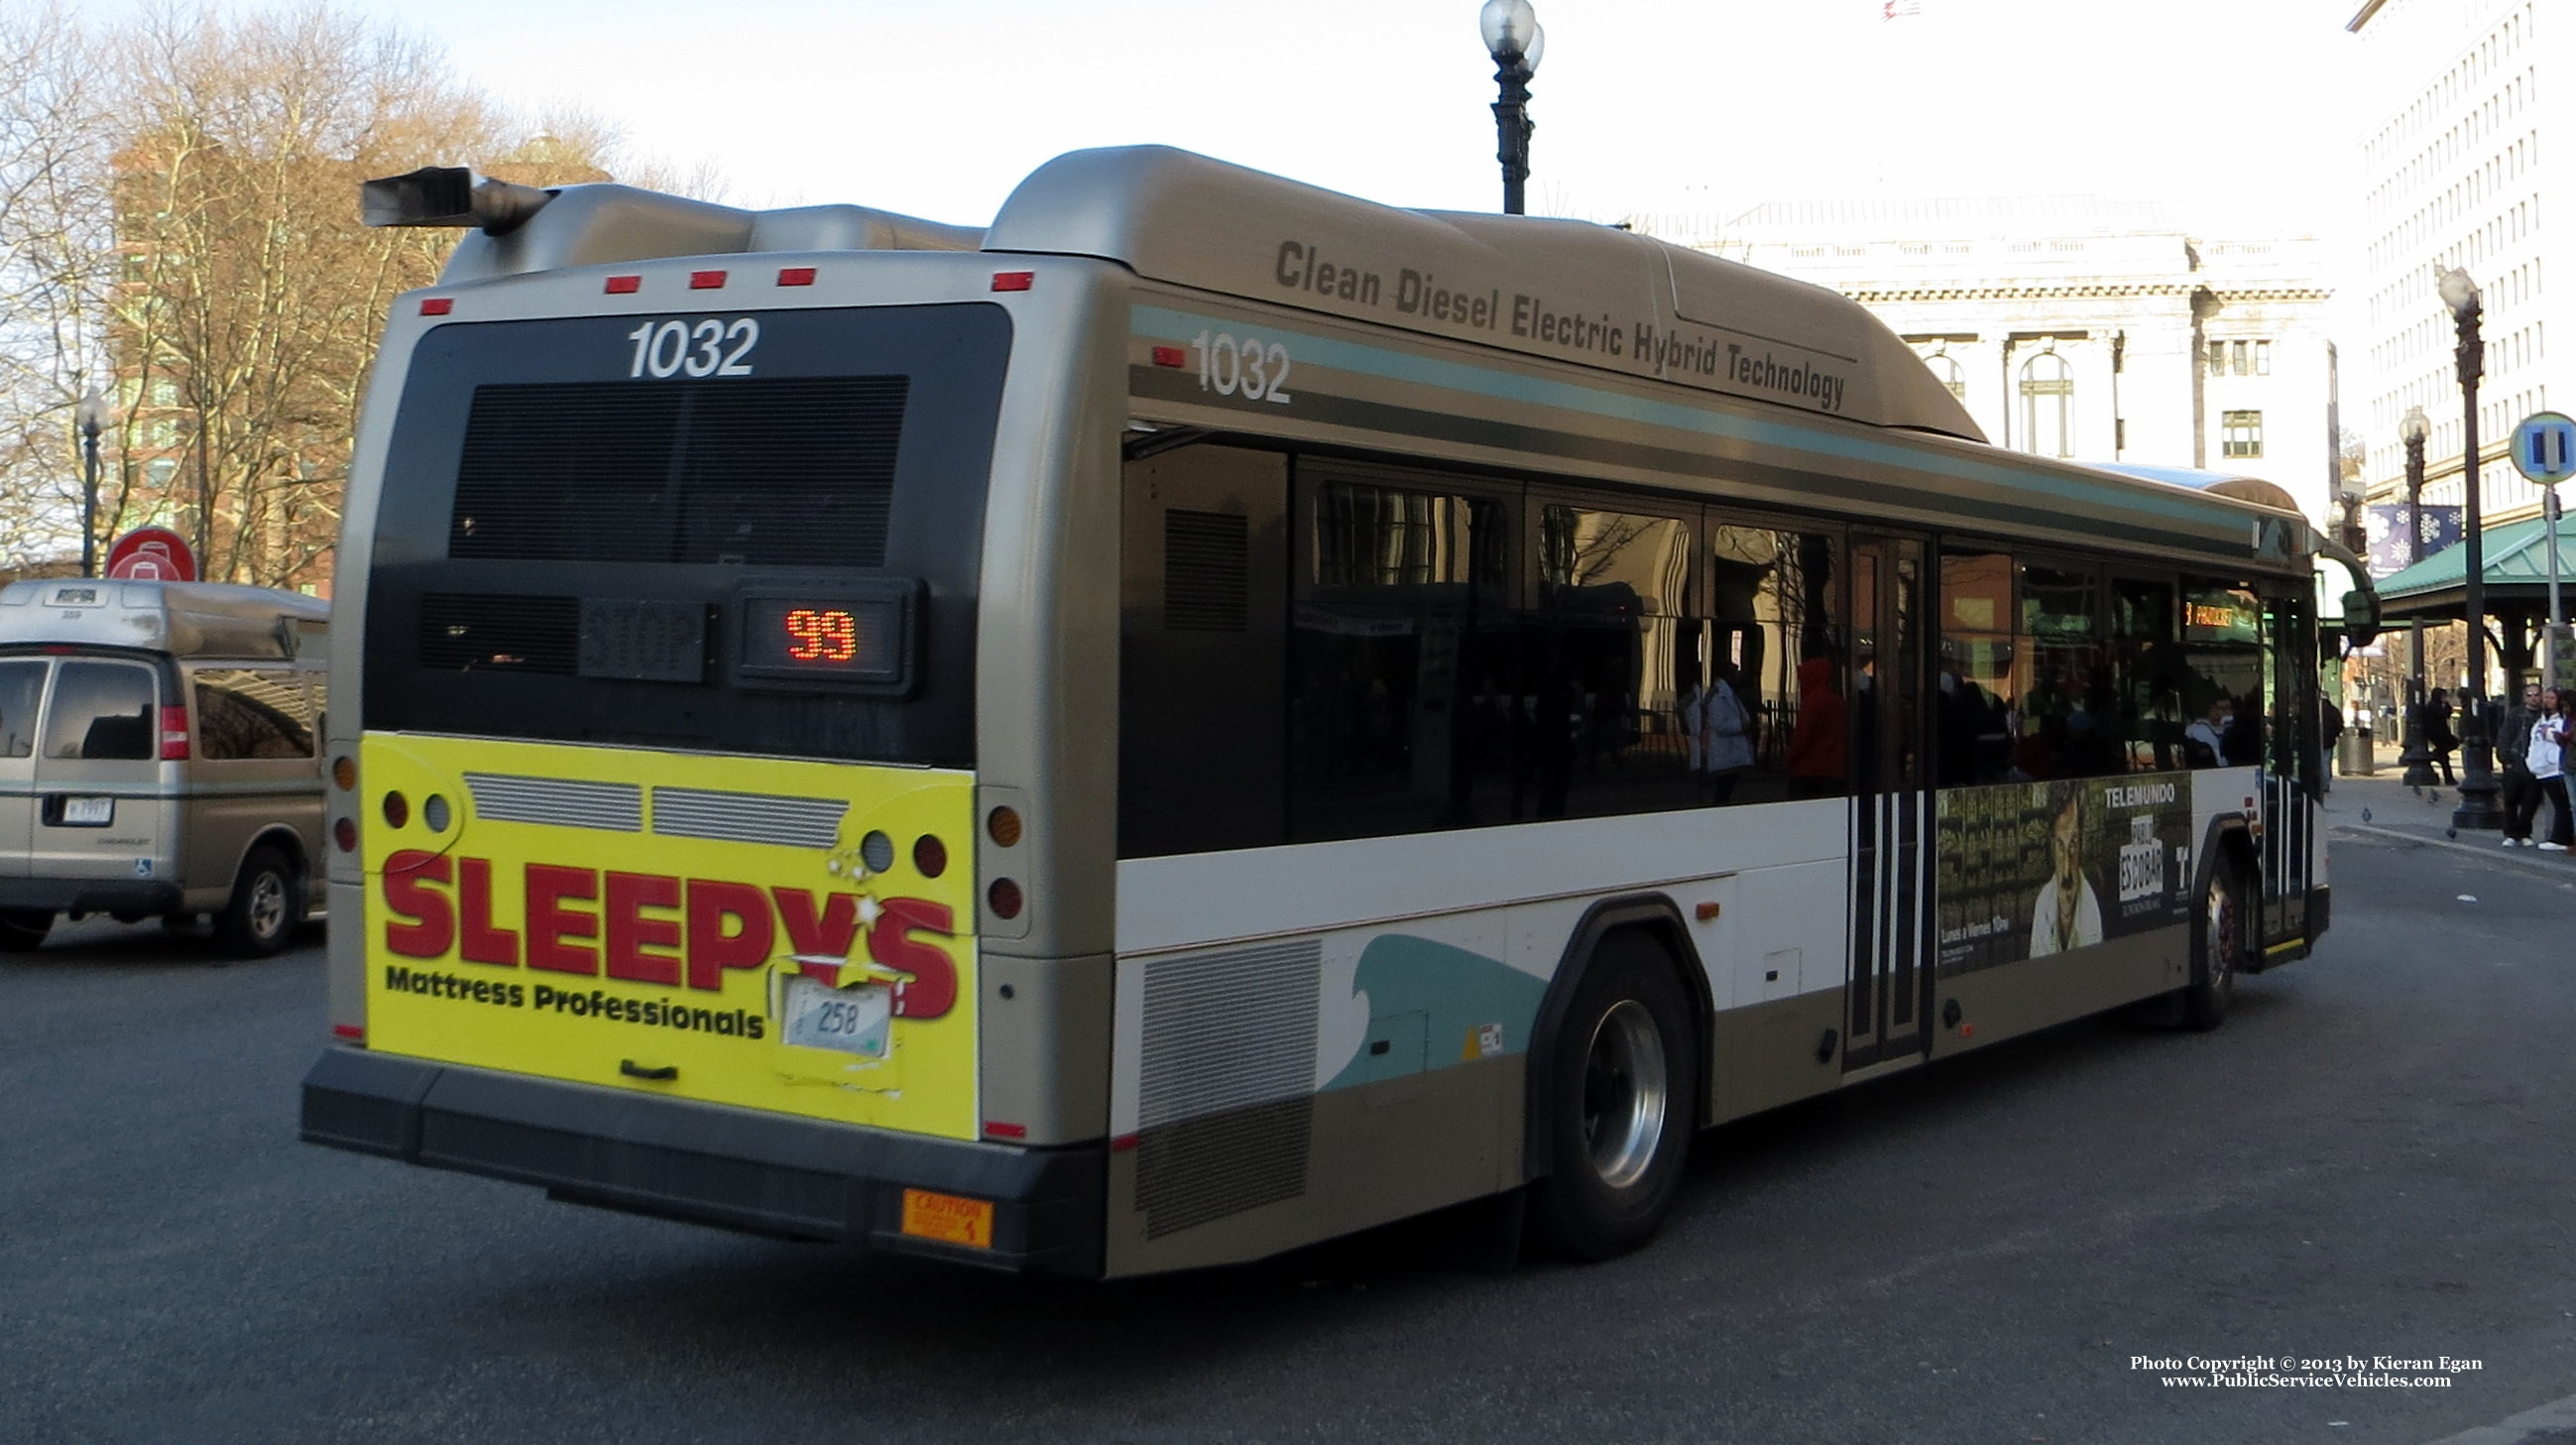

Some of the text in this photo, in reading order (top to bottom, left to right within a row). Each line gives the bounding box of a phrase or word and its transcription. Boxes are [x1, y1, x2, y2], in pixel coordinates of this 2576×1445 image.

[628, 317, 761, 378] 1032
[1276, 240, 1845, 411] Clean Diesel Electric Hybrid Technology
[1192, 328, 1291, 404] 1032
[785, 609, 857, 661] 99
[2105, 783, 2175, 808] TELEMUNDO
[2121, 848, 2164, 892] ESCOBAR
[385, 966, 525, 1008] Mattress
[534, 984, 765, 1039] Professionals
[818, 1000, 859, 1034] 258
[916, 1194, 982, 1218] CAUTION
